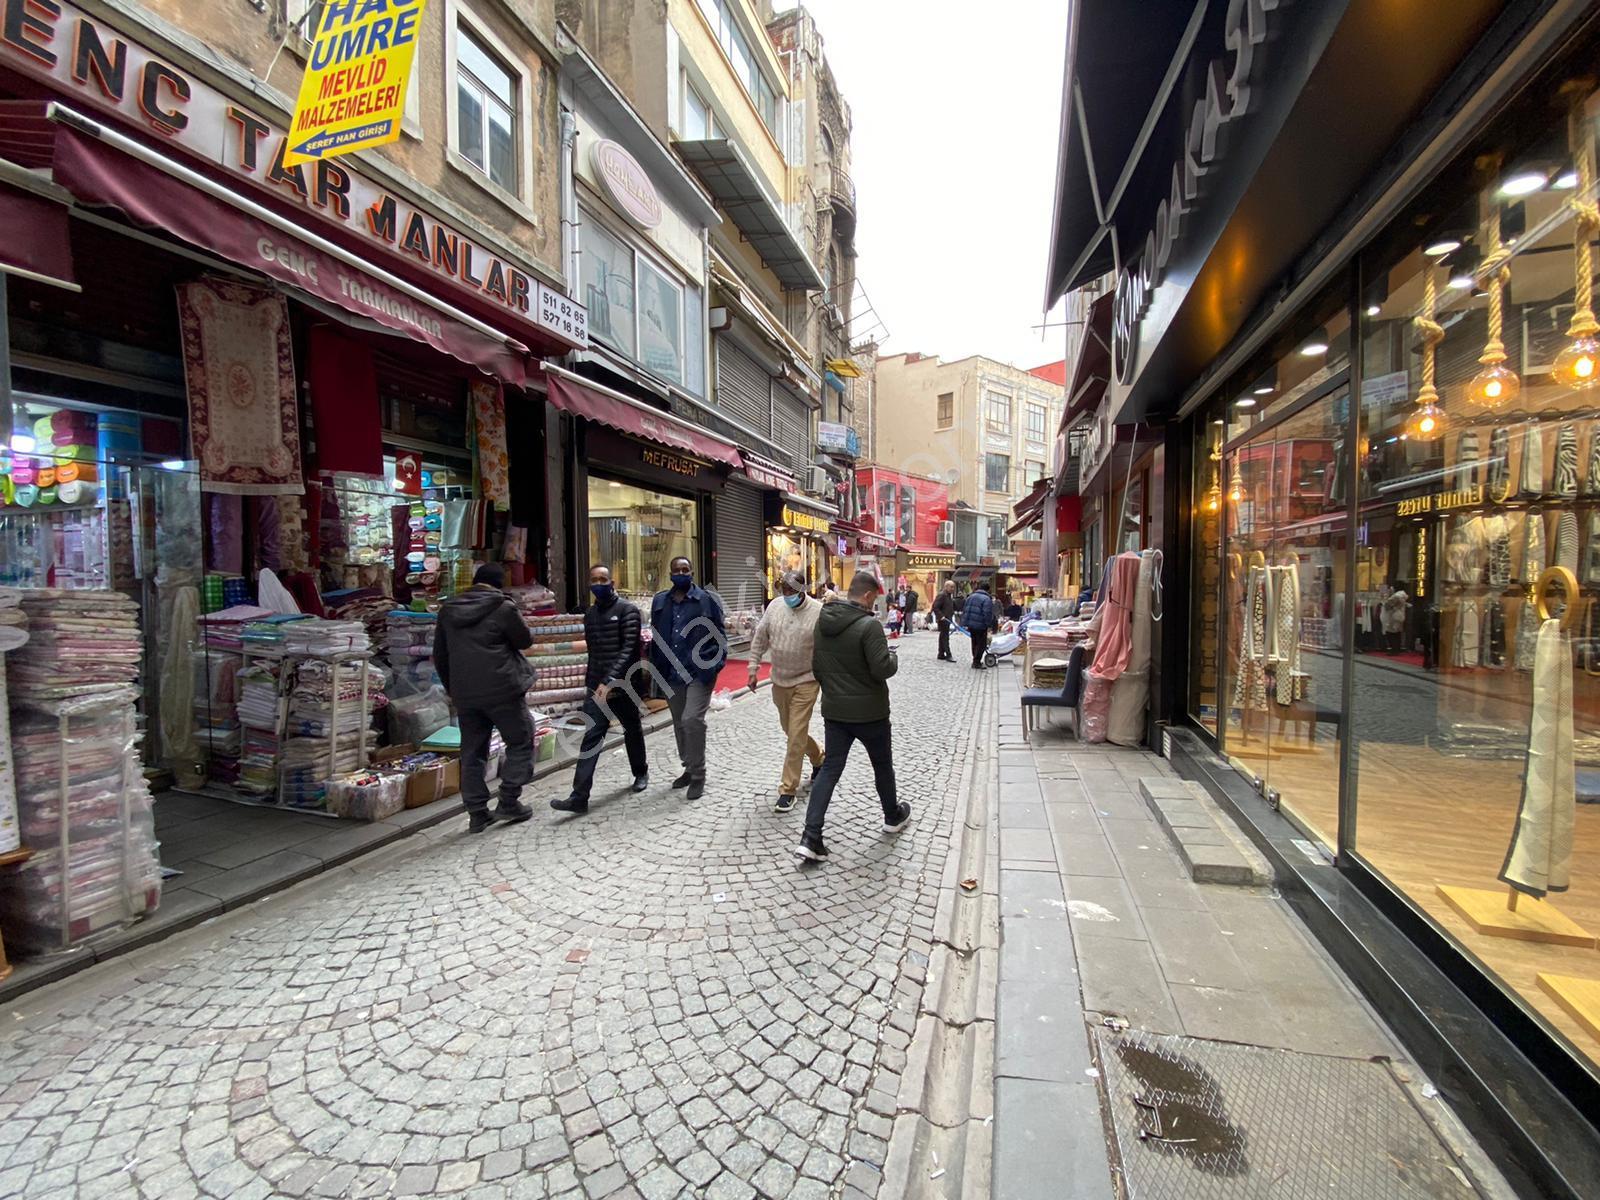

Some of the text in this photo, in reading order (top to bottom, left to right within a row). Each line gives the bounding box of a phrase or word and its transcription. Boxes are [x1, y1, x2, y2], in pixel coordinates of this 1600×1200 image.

[322, 0, 416, 32] HA
[311, 8, 419, 71] UMRE
[318, 55, 388, 101] MEVLİD
[296, 77, 402, 132] MALZEMELERİ
[306, 122, 388, 152] ŞEREF HAN GİRİŞİ
[256, 237, 320, 286] GENÇ
[543, 292, 557, 310] 511
[560, 302, 572, 317] 82
[543, 309, 560, 326] 527
[915, 555, 937, 565] ÖZKAN
